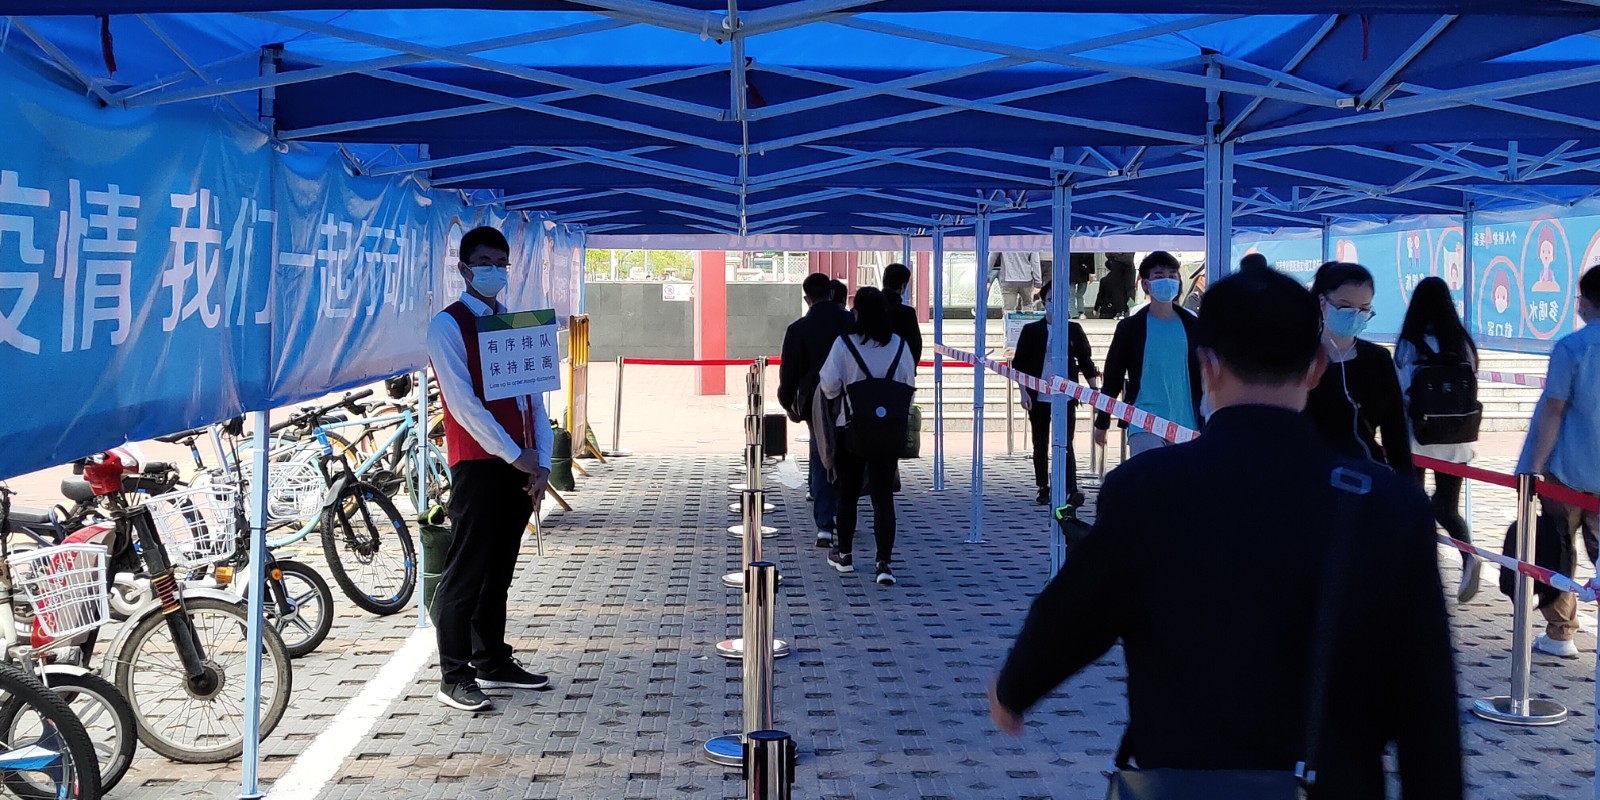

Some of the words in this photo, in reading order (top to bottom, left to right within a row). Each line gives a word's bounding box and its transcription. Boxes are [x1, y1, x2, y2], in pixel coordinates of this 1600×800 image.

[0, 170, 141, 355] 疫情
[488, 334, 550, 353] 有序排队
[490, 356, 552, 376] 保持距离
